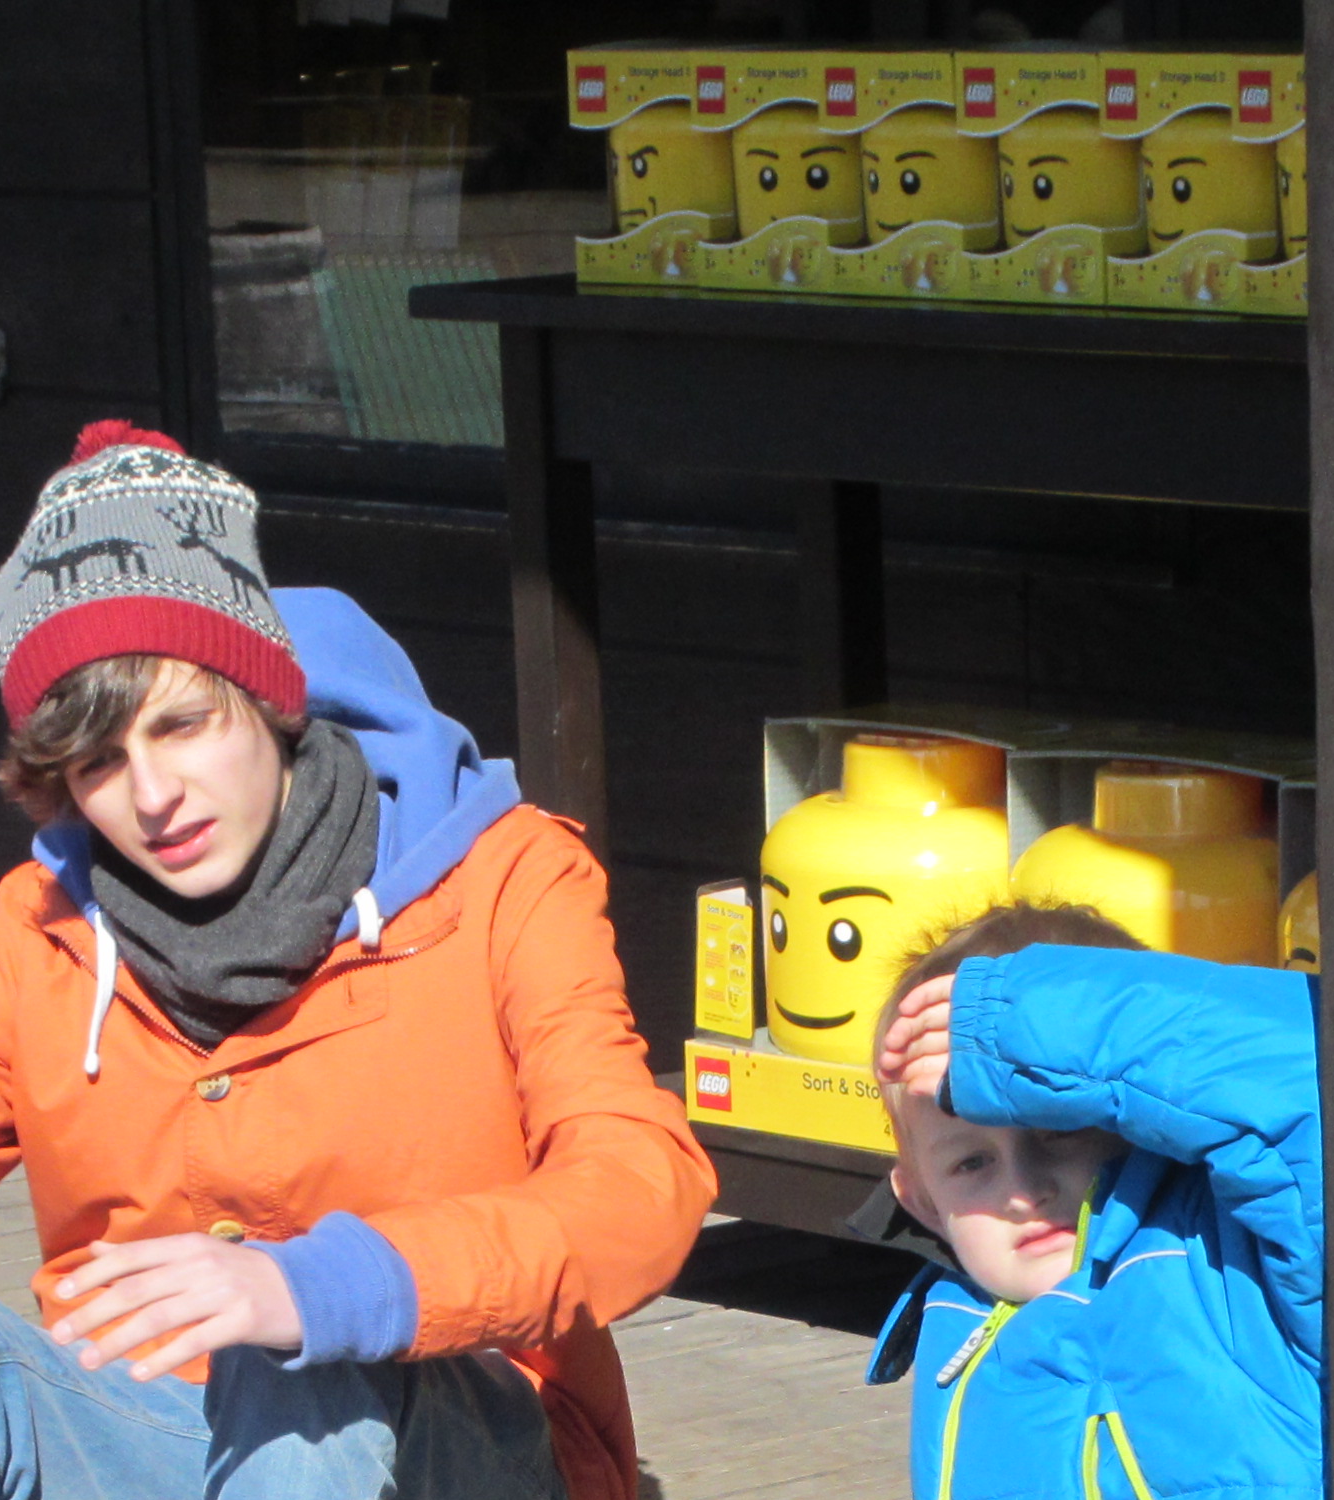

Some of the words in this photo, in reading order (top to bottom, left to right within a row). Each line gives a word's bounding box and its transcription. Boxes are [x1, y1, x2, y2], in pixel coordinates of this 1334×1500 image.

[878, 68, 910, 83] Storage
[1019, 68, 1052, 83] Storage
[1160, 70, 1193, 85] Storage
[578, 80, 603, 99] LEGO
[699, 81, 723, 100] LEGO
[828, 82, 854, 101] LEGO
[967, 83, 993, 102] LEGO
[1107, 85, 1134, 104] LEGO
[1241, 87, 1269, 106] LEGO
[698, 1073, 728, 1094] LEGO
[802, 1071, 834, 1094] Sort
[838, 1077, 849, 1096] &
[854, 1080, 880, 1100] Sto
